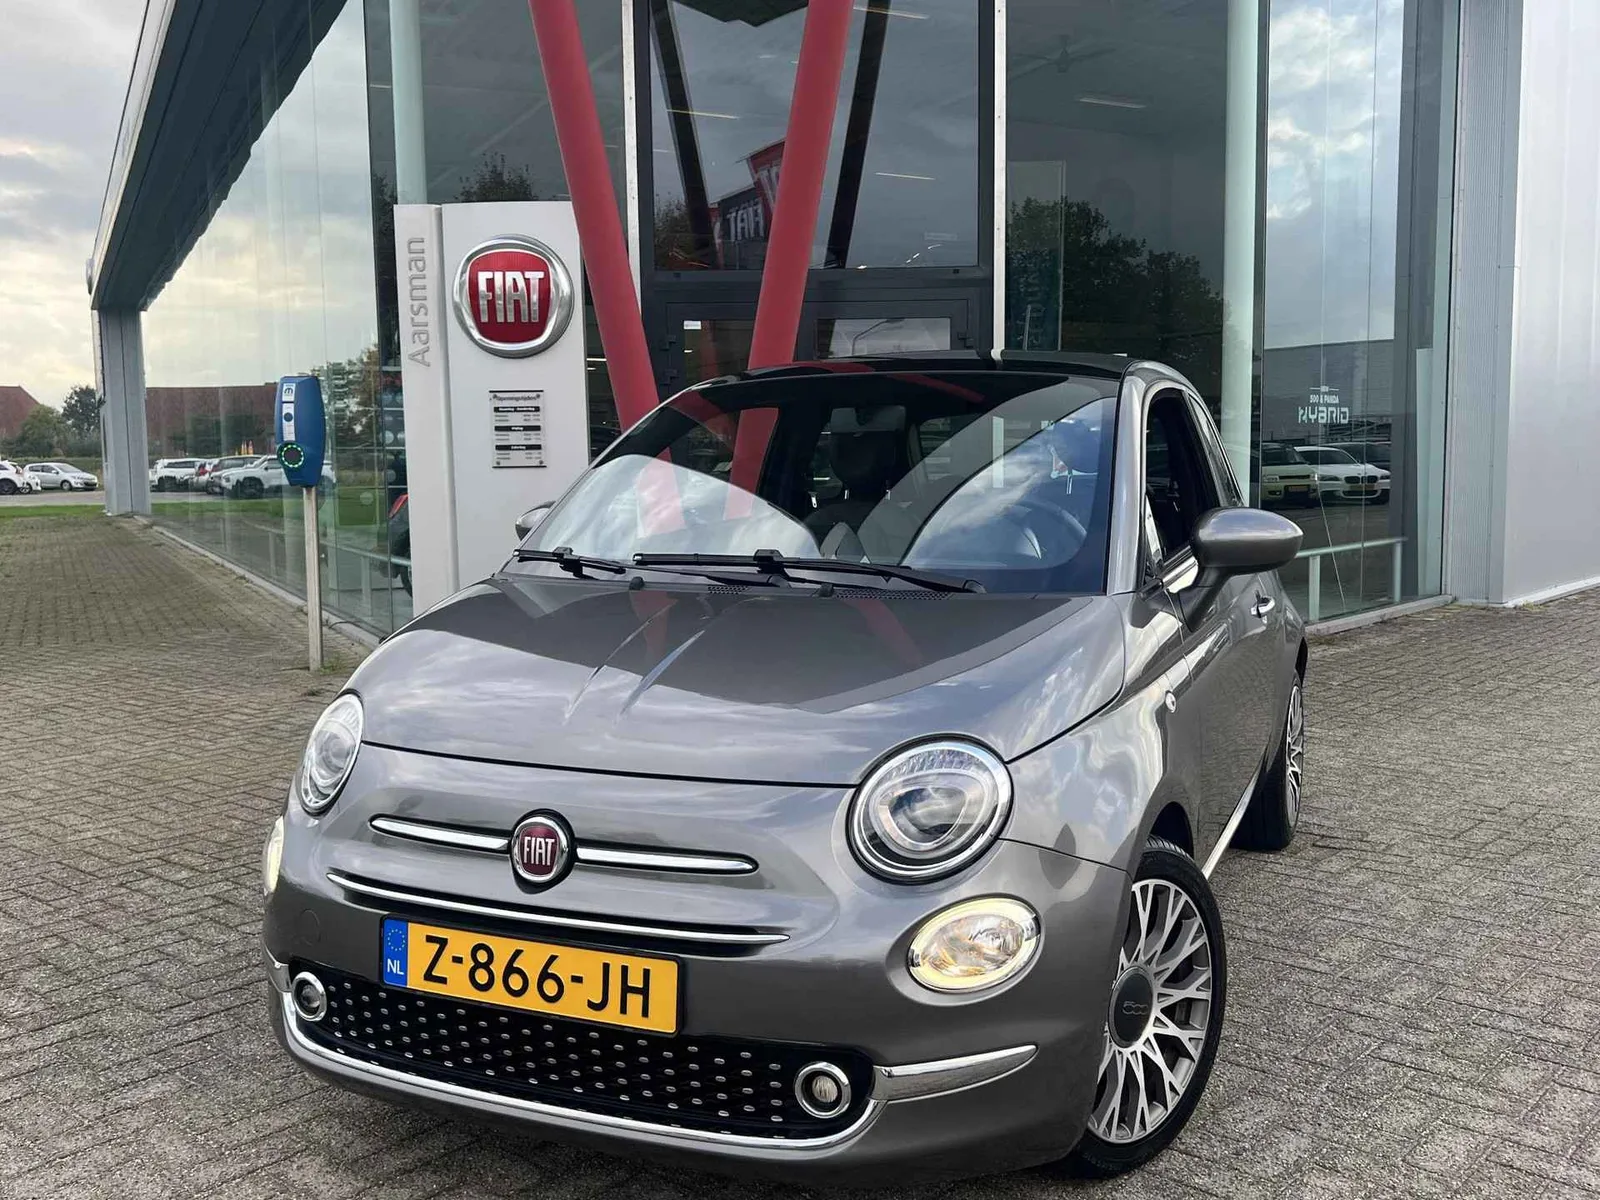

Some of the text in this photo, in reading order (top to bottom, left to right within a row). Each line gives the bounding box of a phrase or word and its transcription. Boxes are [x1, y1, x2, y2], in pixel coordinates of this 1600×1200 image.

[407, 236, 431, 367] Aarsman
[477, 271, 545, 323] FIAT
[1298, 406, 1349, 424] HYBRID
[523, 836, 555, 866] FIAT
[387, 958, 404, 975] NL
[423, 934, 651, 1018] Z-866-JH
[1122, 1000, 1149, 1015] 500
